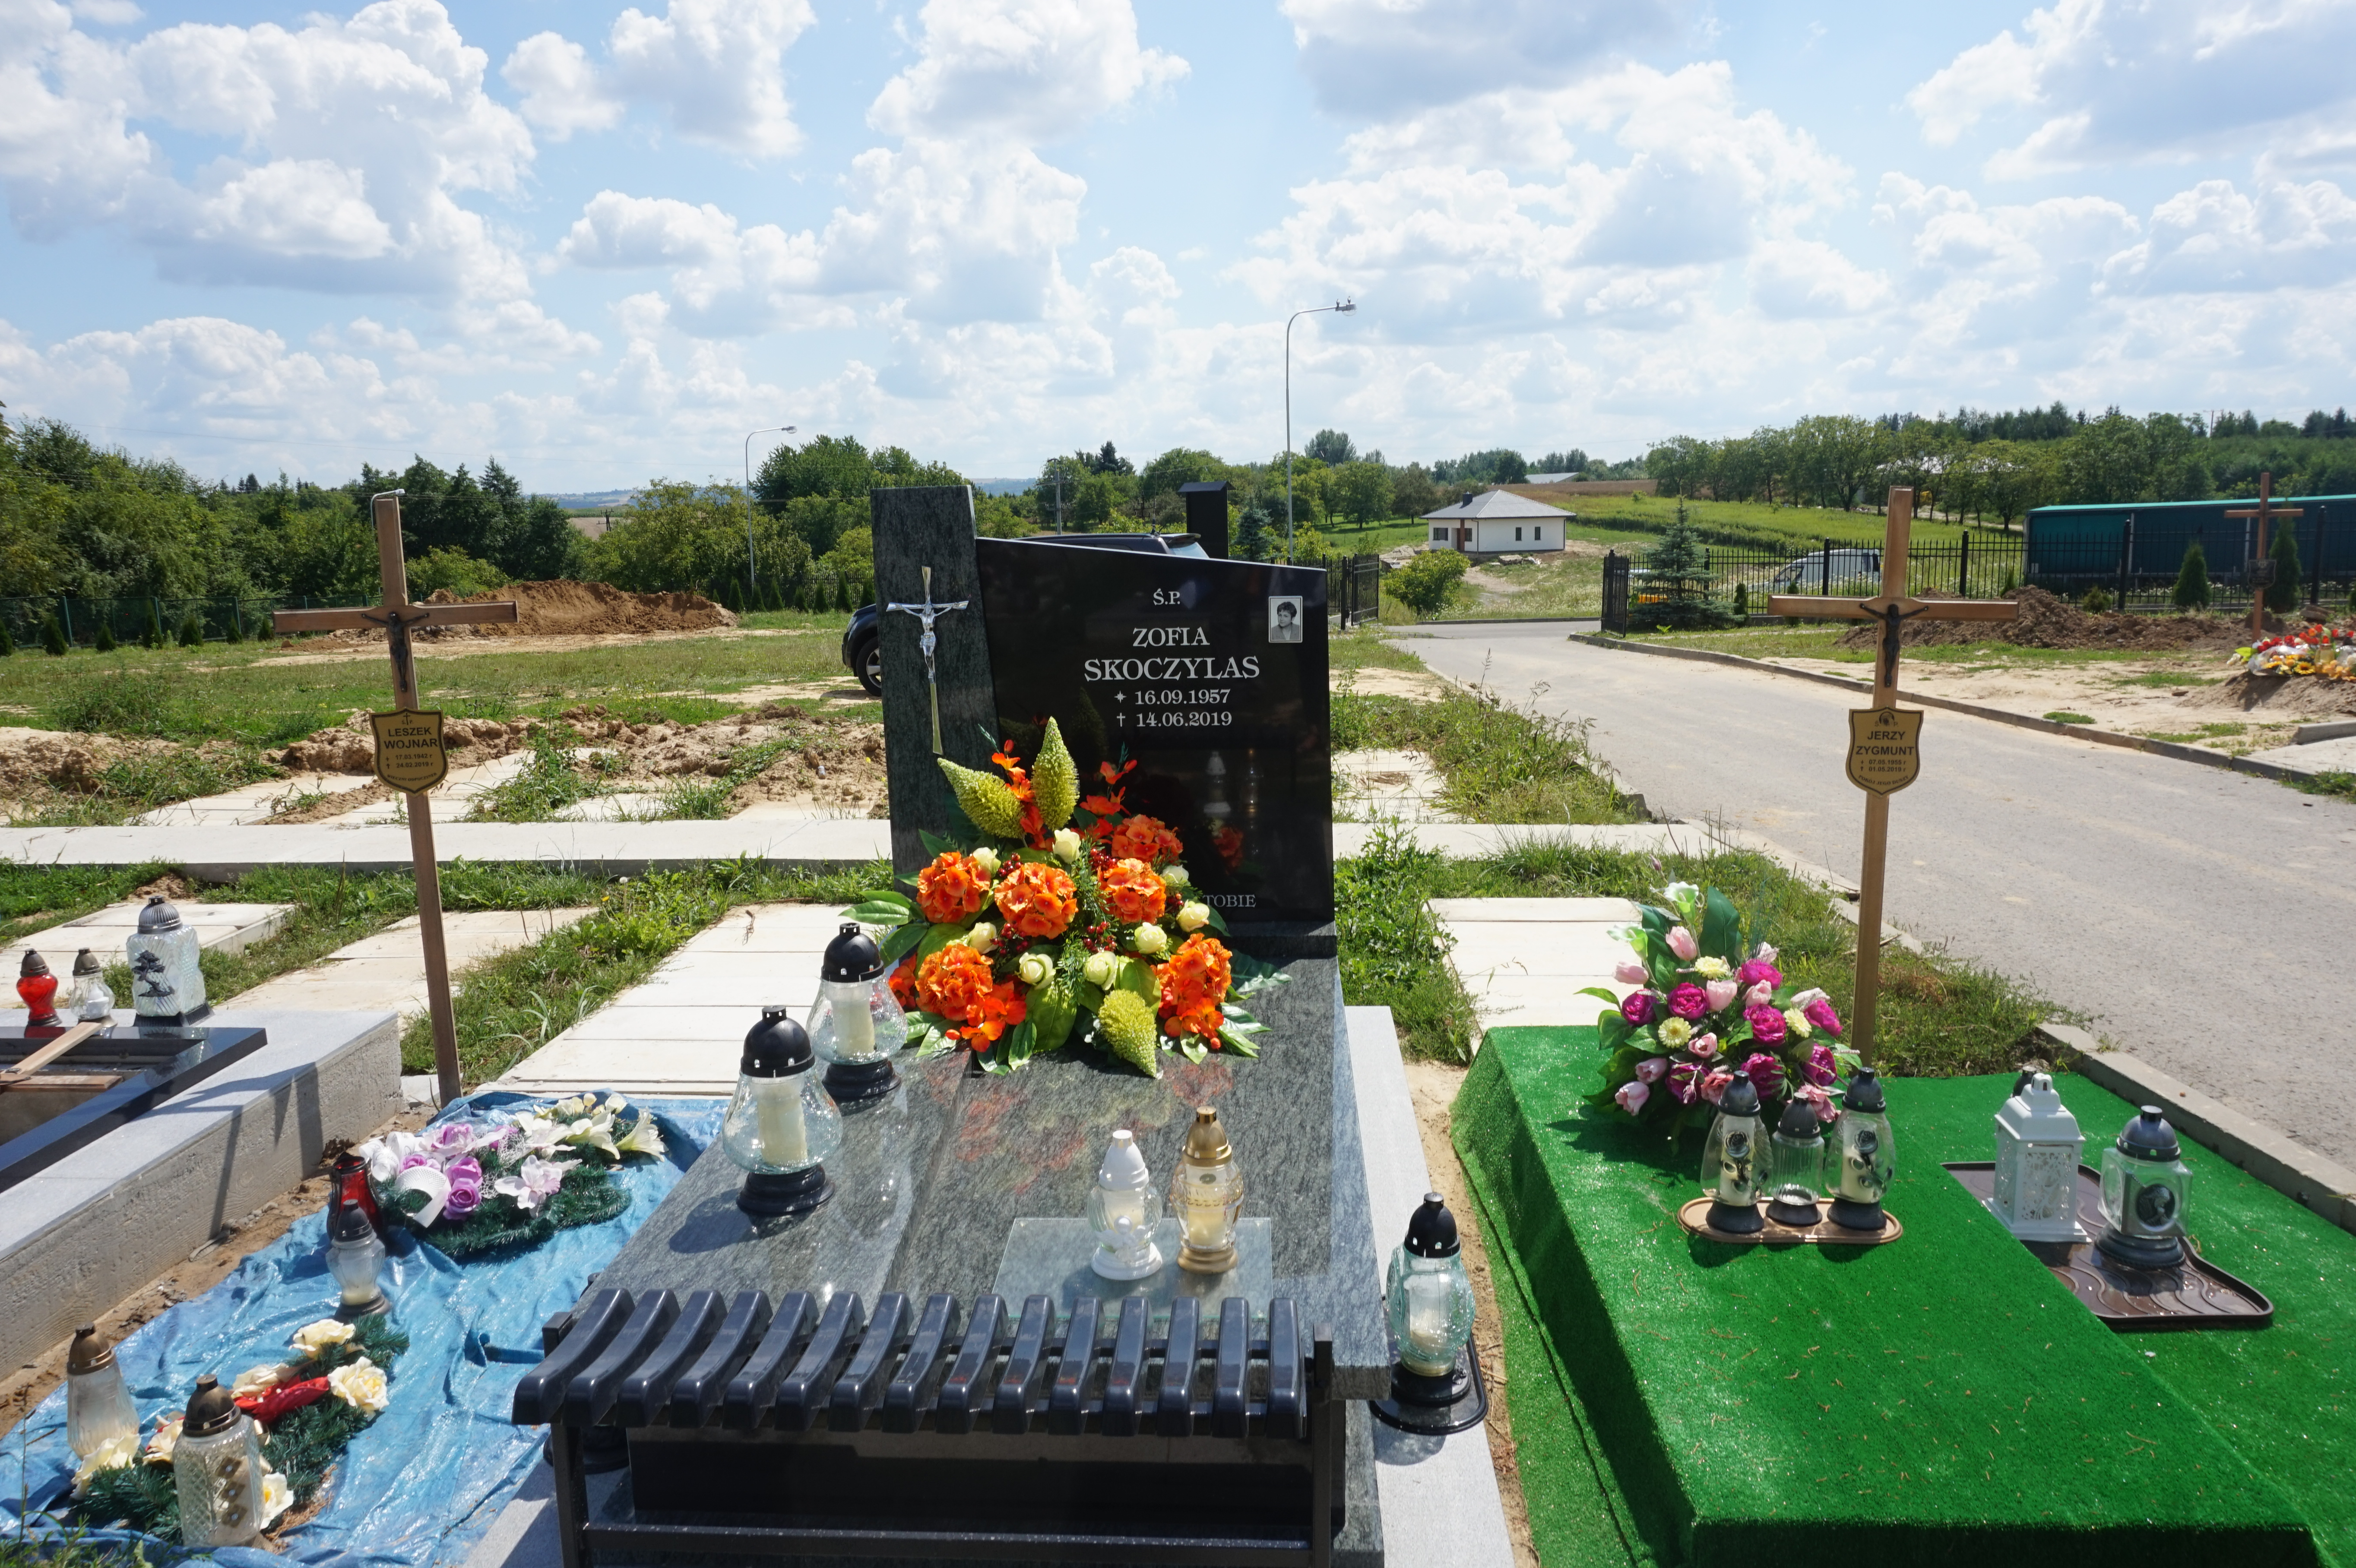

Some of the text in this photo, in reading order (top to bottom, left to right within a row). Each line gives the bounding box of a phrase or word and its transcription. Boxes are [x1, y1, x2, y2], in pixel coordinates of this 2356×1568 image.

[1153, 588, 1181, 606] Ś.P.
[1133, 626, 1210, 648] ZOFIA
[1084, 655, 1260, 682] SKOCZYLAS
[1135, 689, 1231, 705] 16.09.1957
[1136, 711, 1232, 727] 14.06.2019
[388, 727, 432, 737] LESZEK
[1867, 731, 1906, 740] JERZY
[384, 738, 439, 749] WOJNAR
[1856, 746, 1914, 756] ZYGMUNT
[1202, 894, 1256, 907] TOBIE
